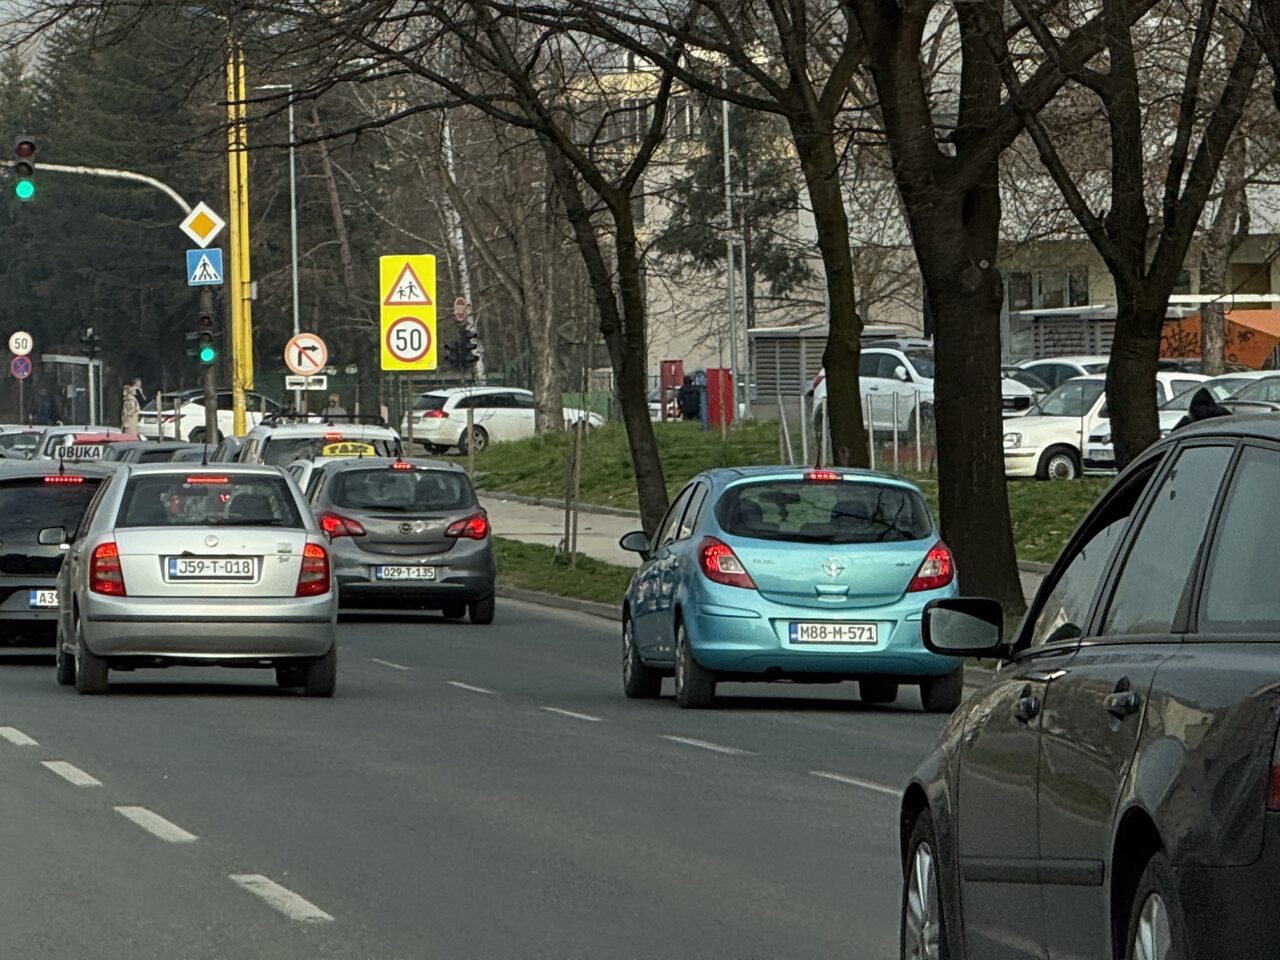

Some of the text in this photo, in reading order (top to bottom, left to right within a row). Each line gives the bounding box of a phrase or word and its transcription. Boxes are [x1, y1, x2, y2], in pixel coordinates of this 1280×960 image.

[14, 337, 28, 350] 50
[396, 328, 422, 352] 50
[58, 446, 100, 458] OBUKA
[179, 560, 251, 574] J59-T-018
[39, 592, 58, 604] A3
[800, 625, 875, 641] M88-M-571
